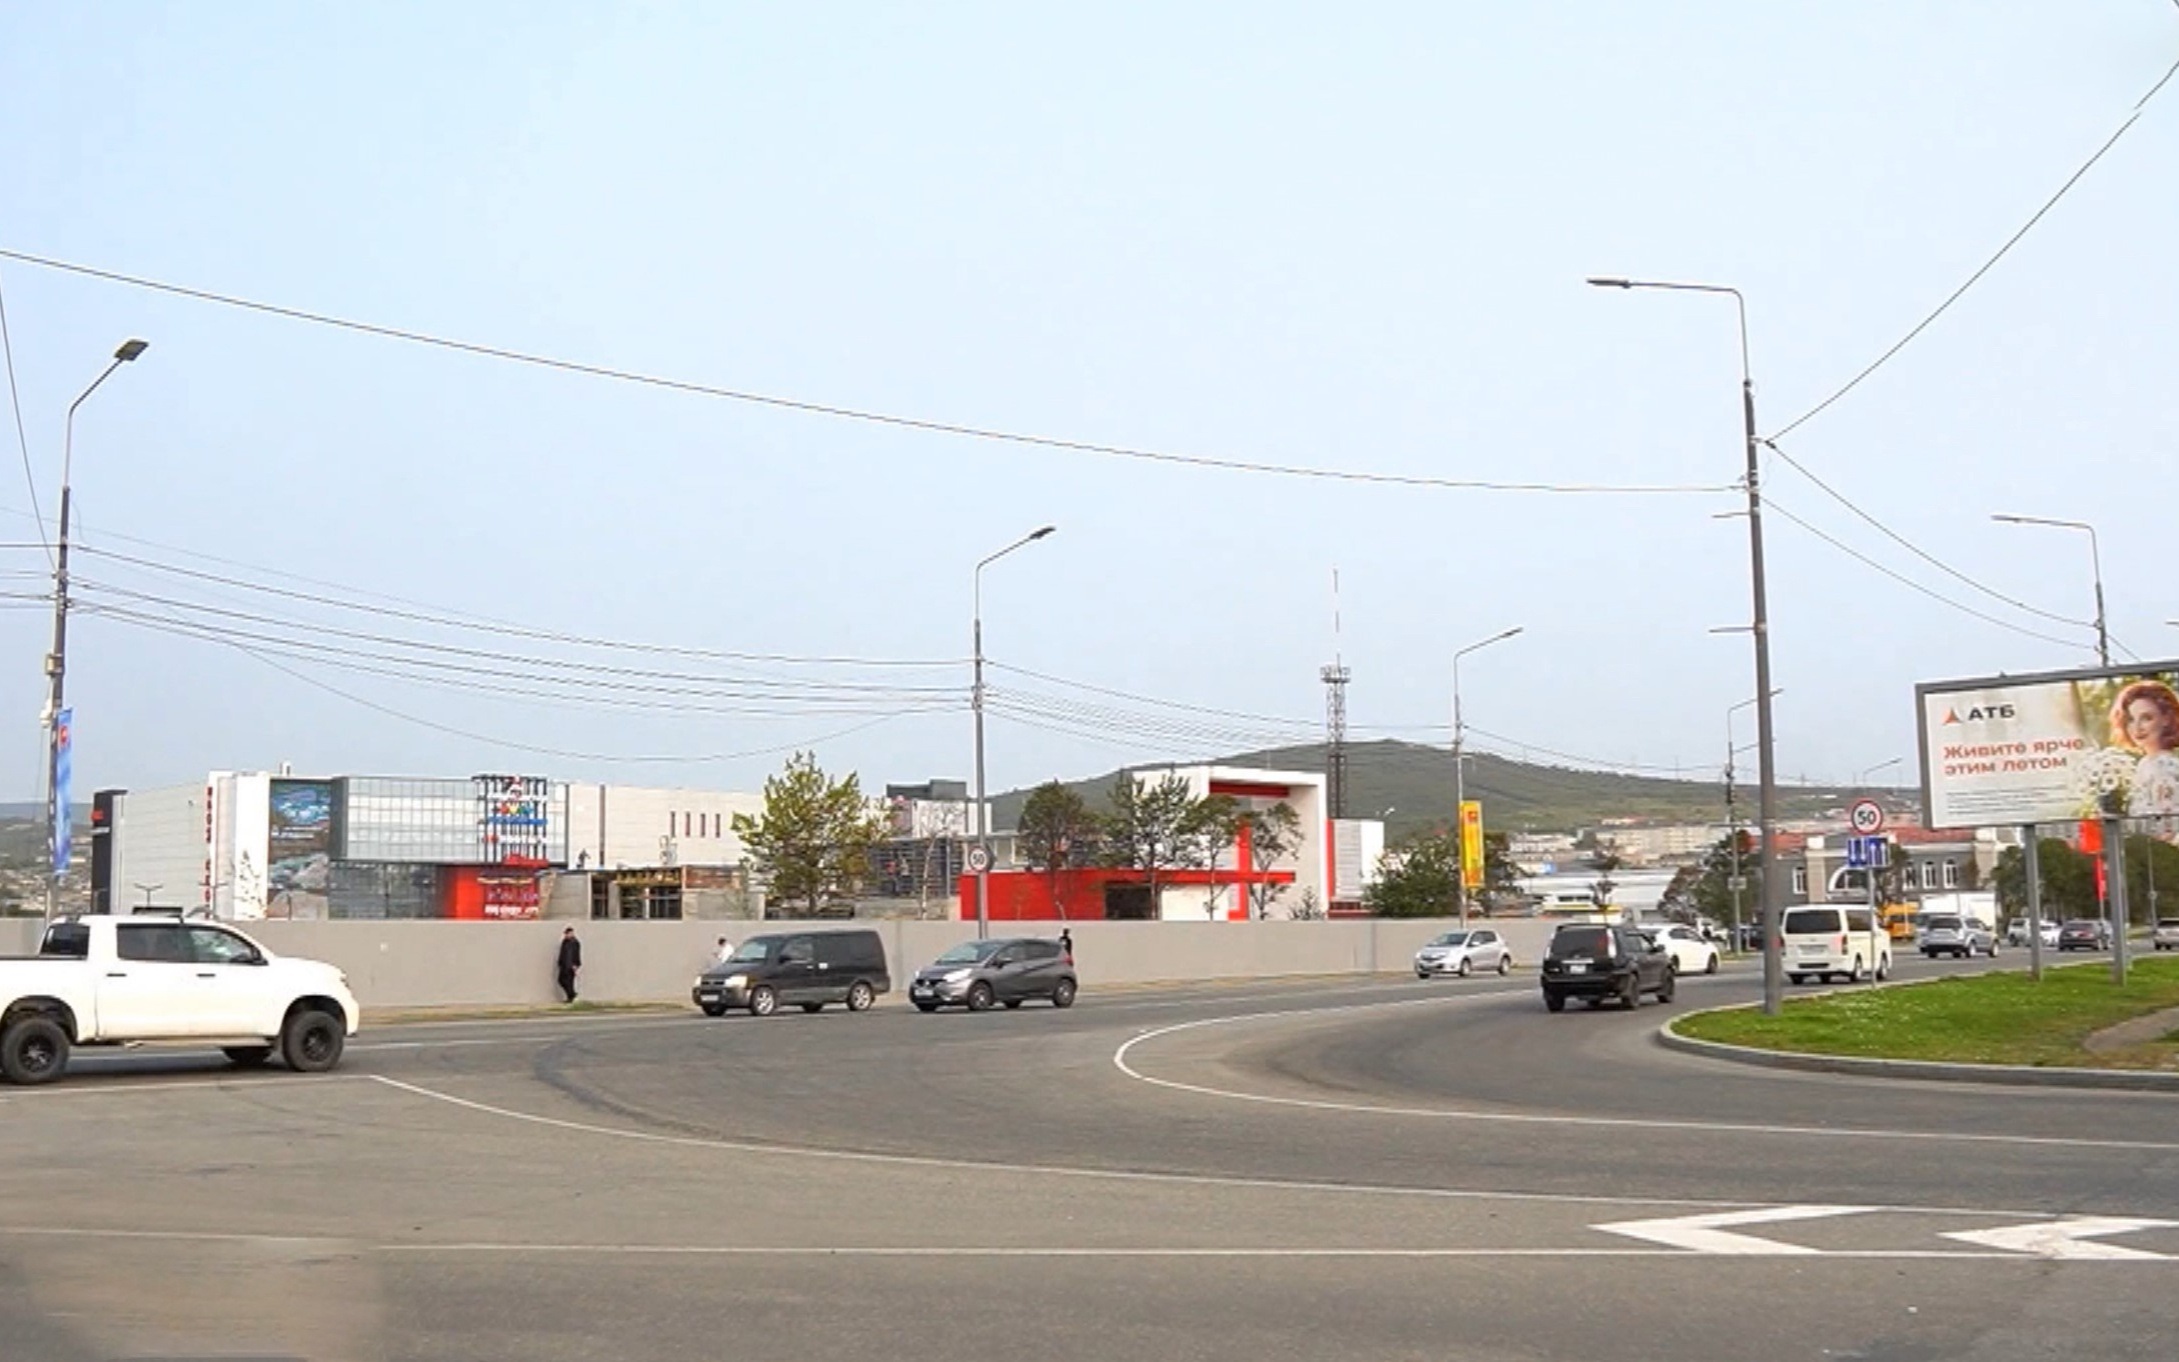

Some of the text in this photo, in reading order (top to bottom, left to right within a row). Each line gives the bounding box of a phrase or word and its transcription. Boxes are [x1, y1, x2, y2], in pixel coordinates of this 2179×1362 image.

[1968, 704, 2015, 721] АТБ
[1944, 742, 2027, 759] Живите
[1945, 757, 2068, 776] этим летом
[1857, 810, 1877, 825] 50
